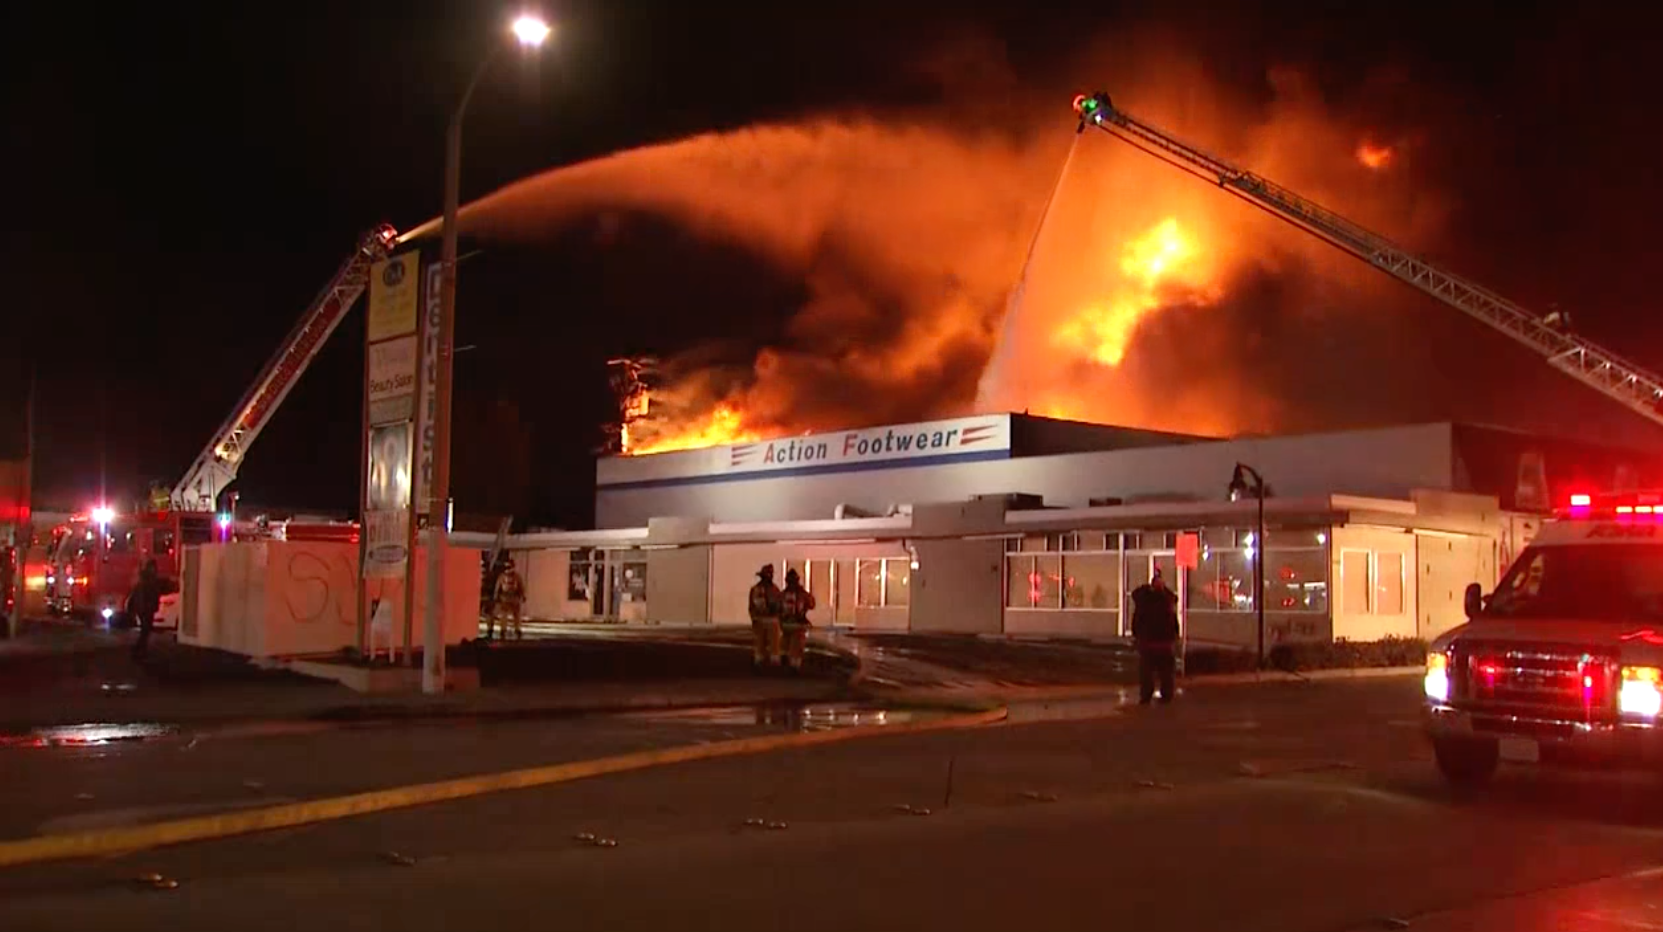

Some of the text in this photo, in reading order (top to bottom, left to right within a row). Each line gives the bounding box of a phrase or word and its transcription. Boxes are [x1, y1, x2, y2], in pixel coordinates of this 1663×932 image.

[370, 374, 414, 393] Beauty Salon
[763, 428, 958, 465] Action Footwear
